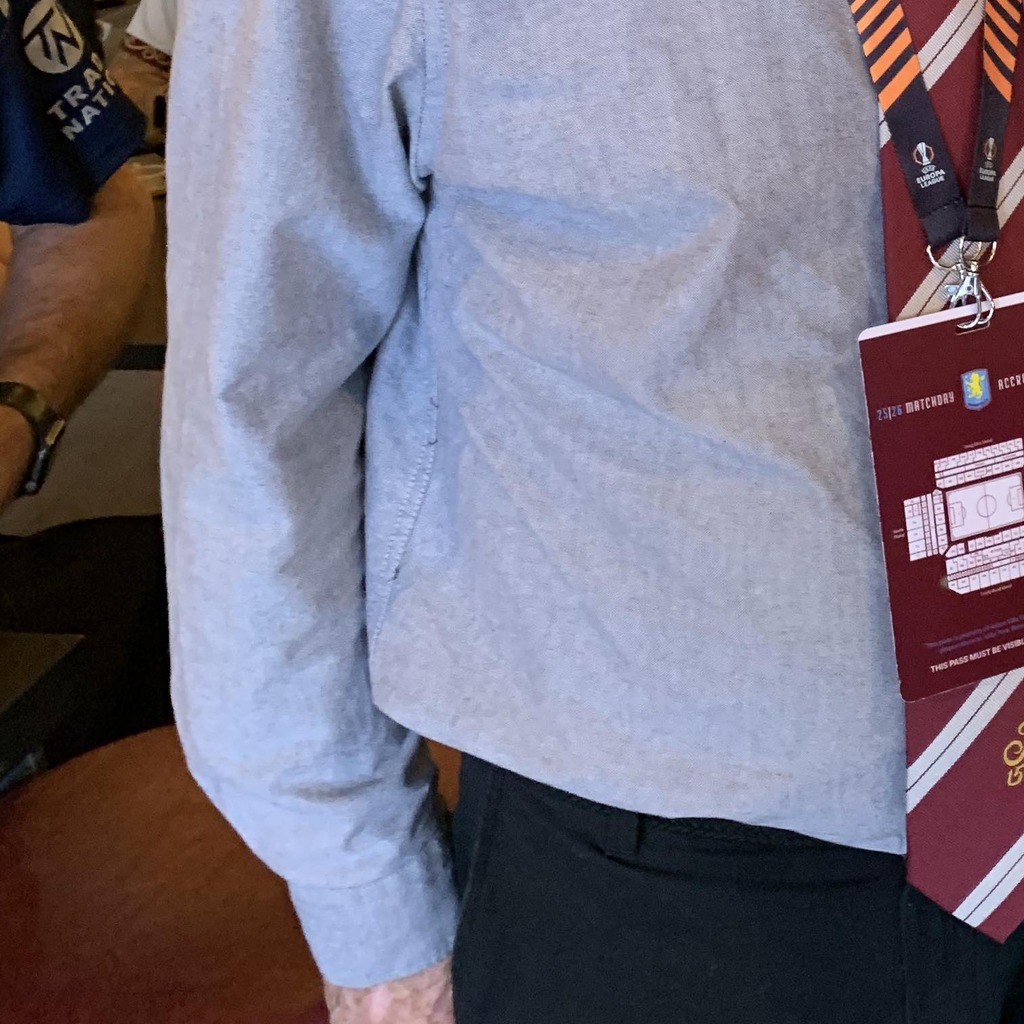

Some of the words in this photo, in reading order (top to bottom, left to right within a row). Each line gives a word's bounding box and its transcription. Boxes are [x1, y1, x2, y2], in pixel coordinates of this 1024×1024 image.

[916, 169, 946, 184] EUROPA
[920, 175, 945, 188] LEAGUE
[905, 391, 955, 414] MATCHDAY
[930, 660, 948, 673] THIS
[949, 655, 969, 667] PASS
[969, 649, 991, 662] MUST
[992, 644, 1002, 654] BE
